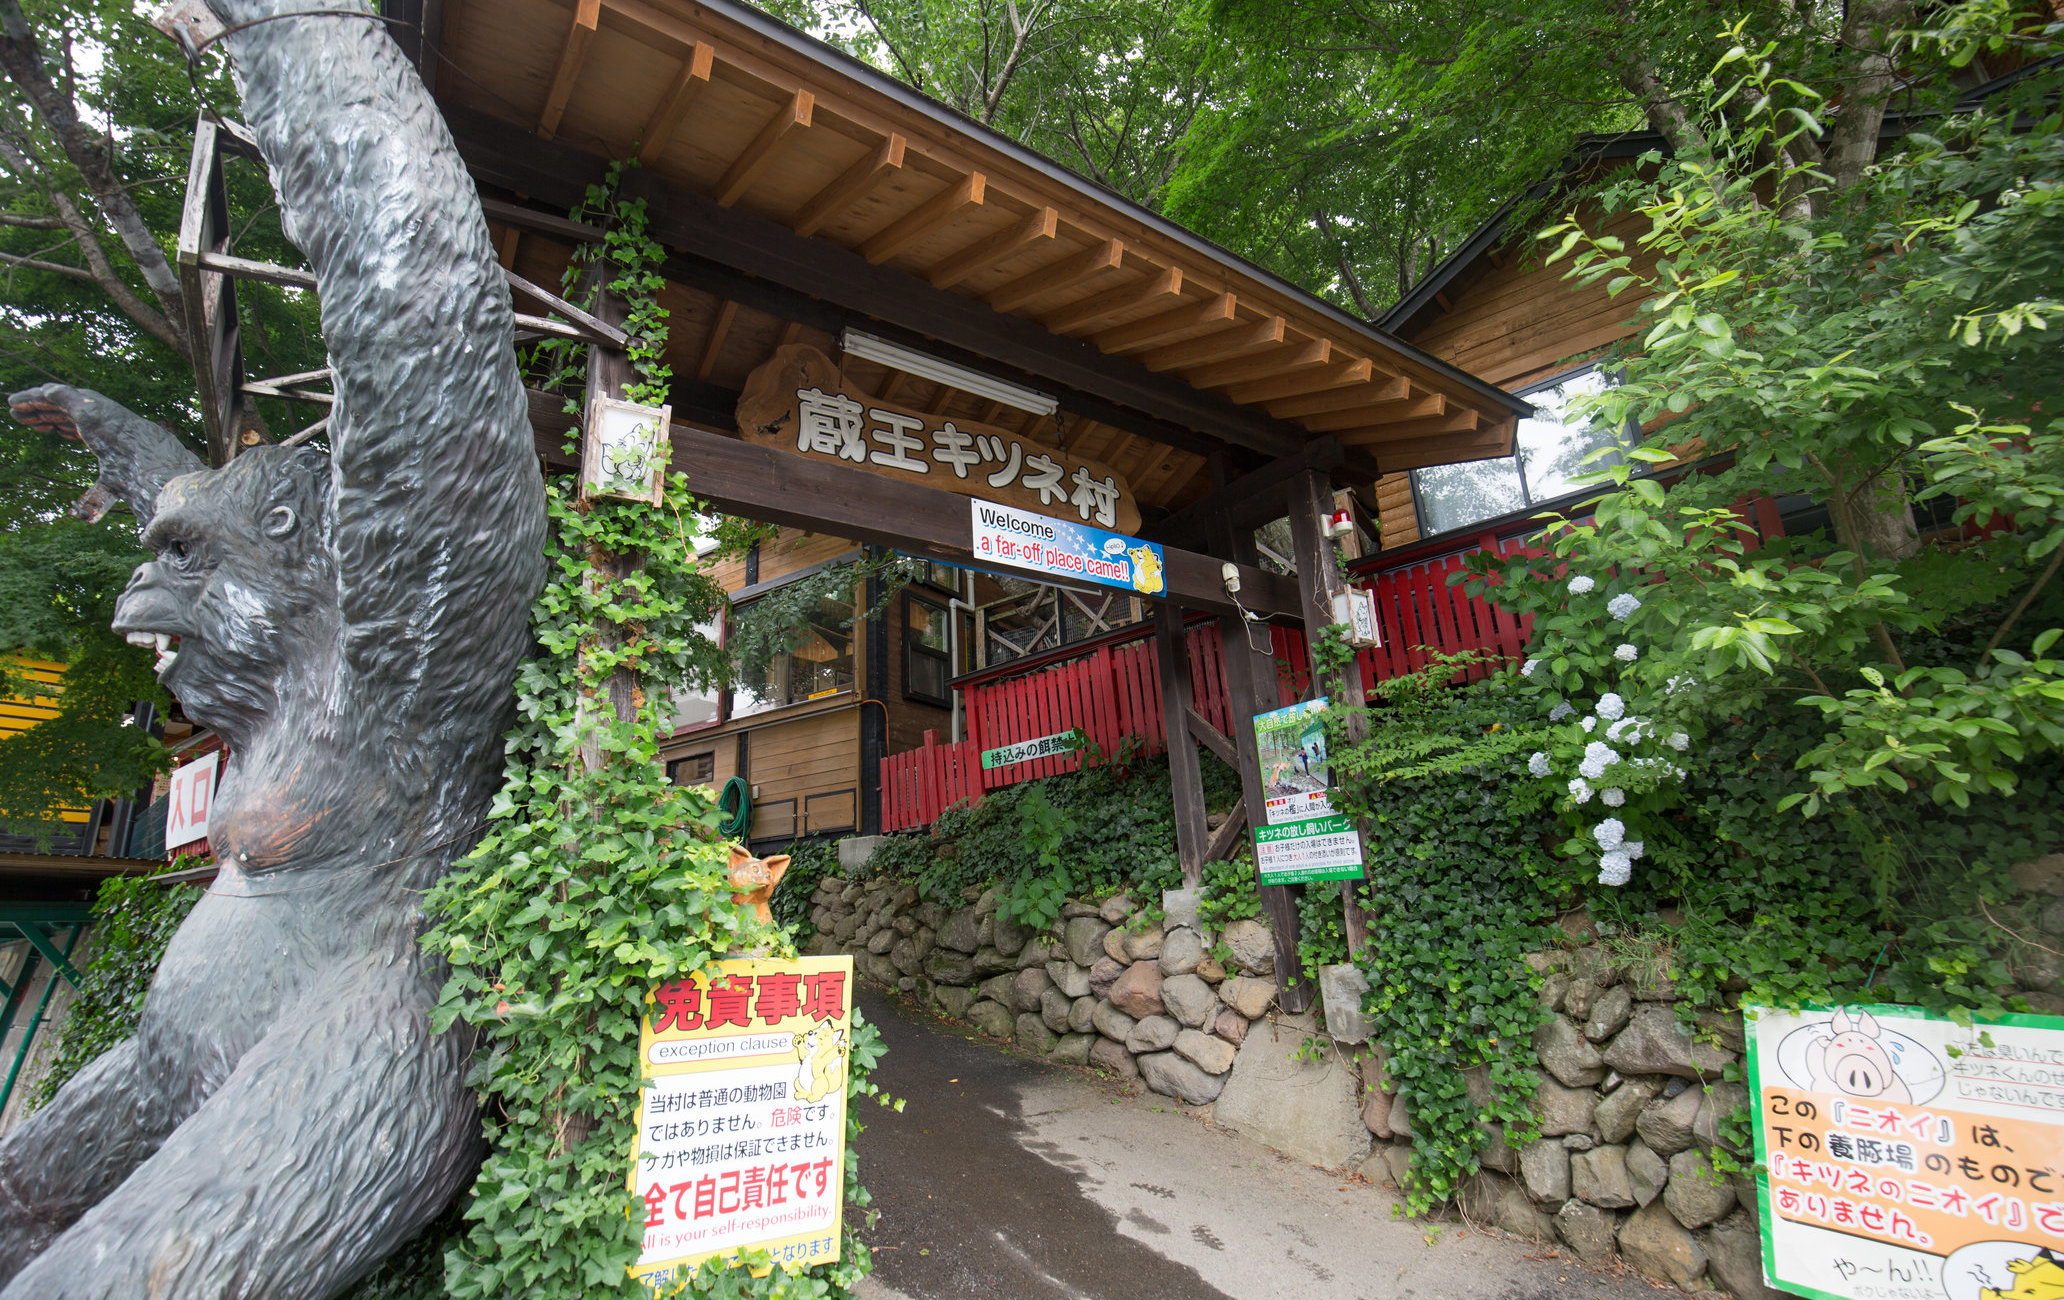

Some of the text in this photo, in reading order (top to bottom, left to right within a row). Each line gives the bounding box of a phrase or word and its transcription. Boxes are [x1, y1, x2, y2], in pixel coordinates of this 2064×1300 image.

[796, 387, 1121, 528] 蔵王キツネ村
[980, 506, 1054, 539] Welcome
[981, 534, 1130, 581] a far-off place came!!
[170, 766, 212, 833] 入口
[1259, 818, 1351, 841] キツネの放し飼いパーク
[653, 971, 846, 1034] 免責事項
[659, 1035, 788, 1058] exception clause
[650, 1081, 787, 1114] 当村は普通の動物園
[649, 1103, 835, 1142] ではありません。 危険です。
[646, 1131, 834, 1172] ケガや物損は保証できません。
[1772, 1126, 2064, 1193] 下の養豚場のもので
[644, 1156, 833, 1228] 全て自己責任です
[641, 1204, 833, 1250] ll is your self-responsibility.
[1778, 1188, 1930, 1245] ありません。
